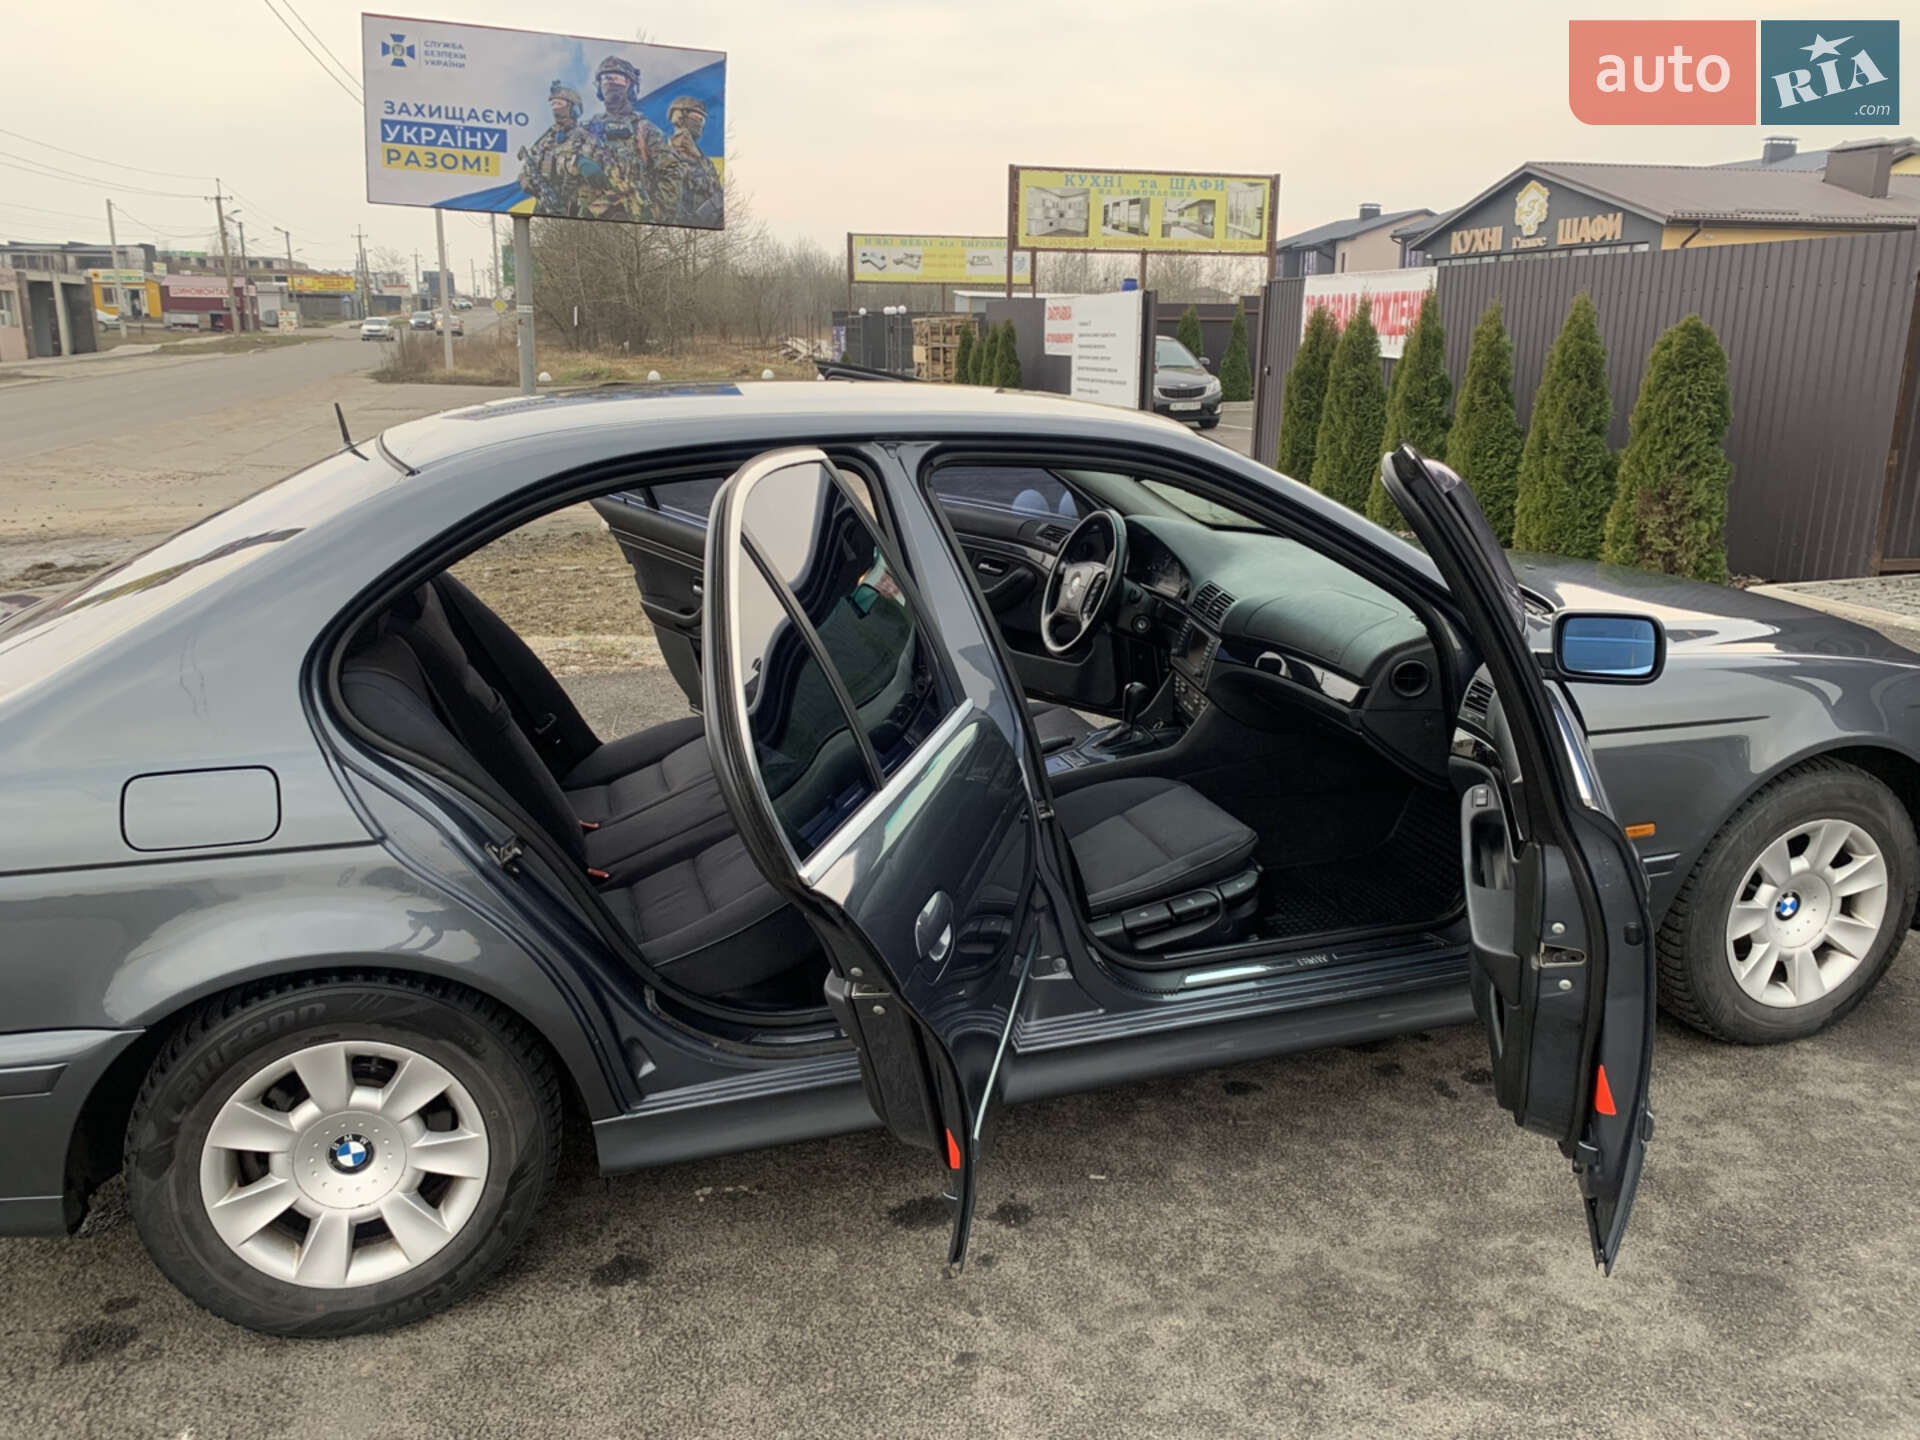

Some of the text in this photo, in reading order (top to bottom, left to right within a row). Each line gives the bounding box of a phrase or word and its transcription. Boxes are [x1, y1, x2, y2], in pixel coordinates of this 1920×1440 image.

[424, 40, 465, 50] СЛУЖБА
[424, 50, 466, 60] БЕЗПЕКИ
[425, 59, 466, 69] УКРАЇНИ
[383, 100, 530, 127] ЗАХИЩАЄМО
[384, 123, 501, 150] УКРАЇНУ
[386, 148, 491, 173] РАЗОМ!
[1064, 174, 1226, 191] КУХНІ та ШАФИ
[1451, 225, 1504, 255] КУХНІ
[1556, 212, 1624, 246] ШАФИ
